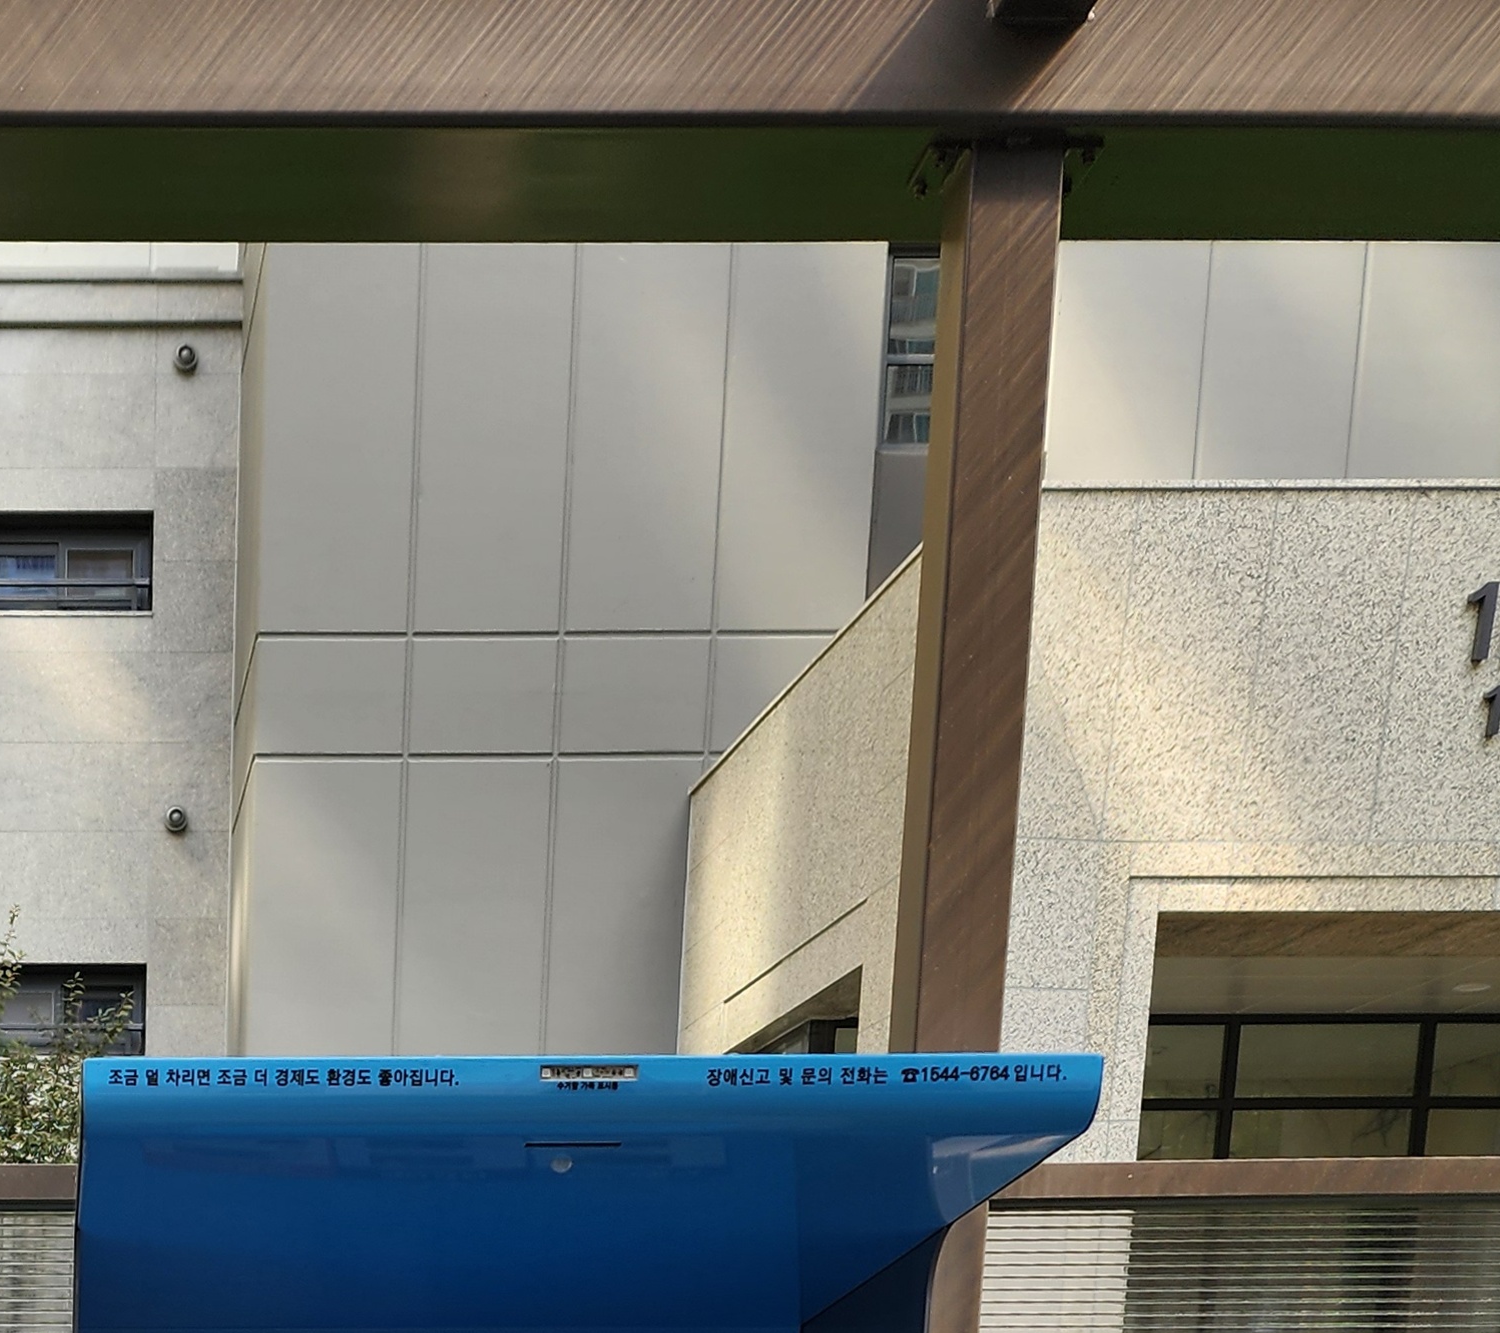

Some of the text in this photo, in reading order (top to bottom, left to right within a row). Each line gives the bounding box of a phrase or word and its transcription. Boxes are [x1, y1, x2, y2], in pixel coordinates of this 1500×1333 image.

[108, 1068, 139, 1086] 조금
[166, 1068, 210, 1087] 차리면
[216, 1068, 247, 1086] 조금
[254, 1068, 268, 1087] 더
[274, 1068, 320, 1087] 경제도
[326, 1068, 372, 1087] 환경도
[378, 1068, 460, 1087] 좋아집니다.
[706, 1067, 771, 1086] 장애신고
[779, 1067, 793, 1086] 및
[800, 1067, 832, 1085] 문의
[840, 1066, 888, 1085] 전화는
[1014, 1064, 1067, 1083] 입니다.
